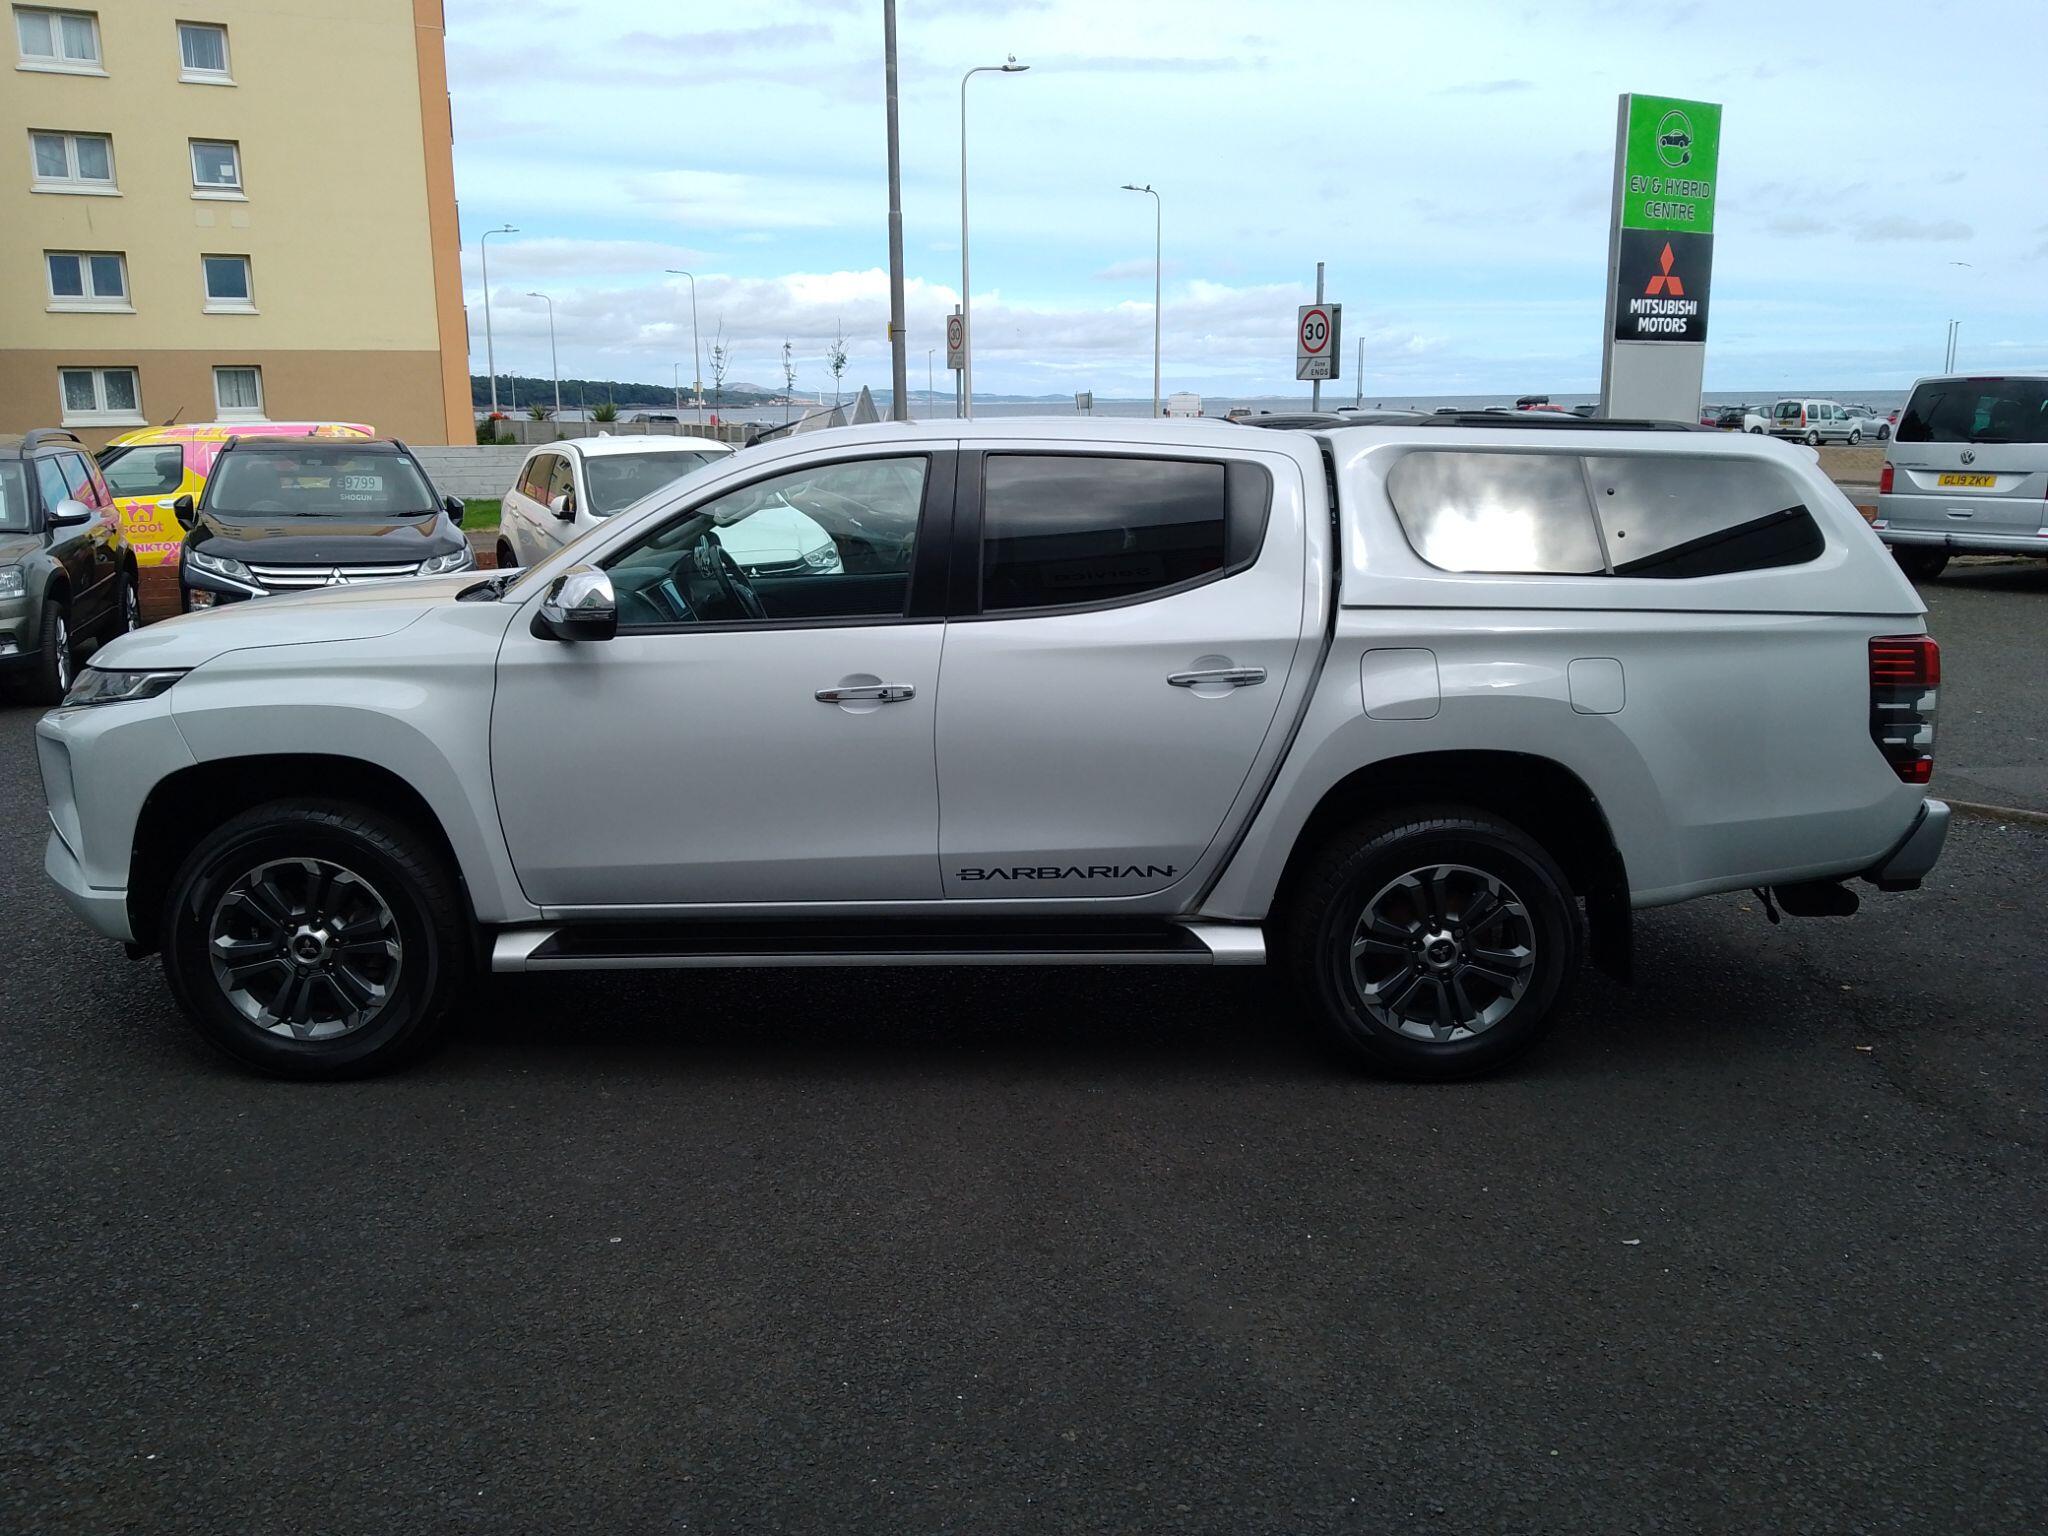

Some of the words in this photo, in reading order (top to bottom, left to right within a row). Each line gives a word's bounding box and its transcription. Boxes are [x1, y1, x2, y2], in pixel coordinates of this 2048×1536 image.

[1630, 176, 1649, 194] EV
[1651, 178, 1662, 194] &
[1664, 179, 1710, 198] HYBRID
[1645, 202, 1694, 219] CENTRE
[1630, 299, 1697, 316] MITSUBISHI
[1305, 323, 1325, 340] 30
[1638, 317, 1687, 333] MOTORS
[1311, 368, 1329, 376] ENDS
[1943, 475, 1967, 485] GL19
[1969, 476, 1991, 485] ZKY
[956, 865, 1178, 881] BARBARIAN
